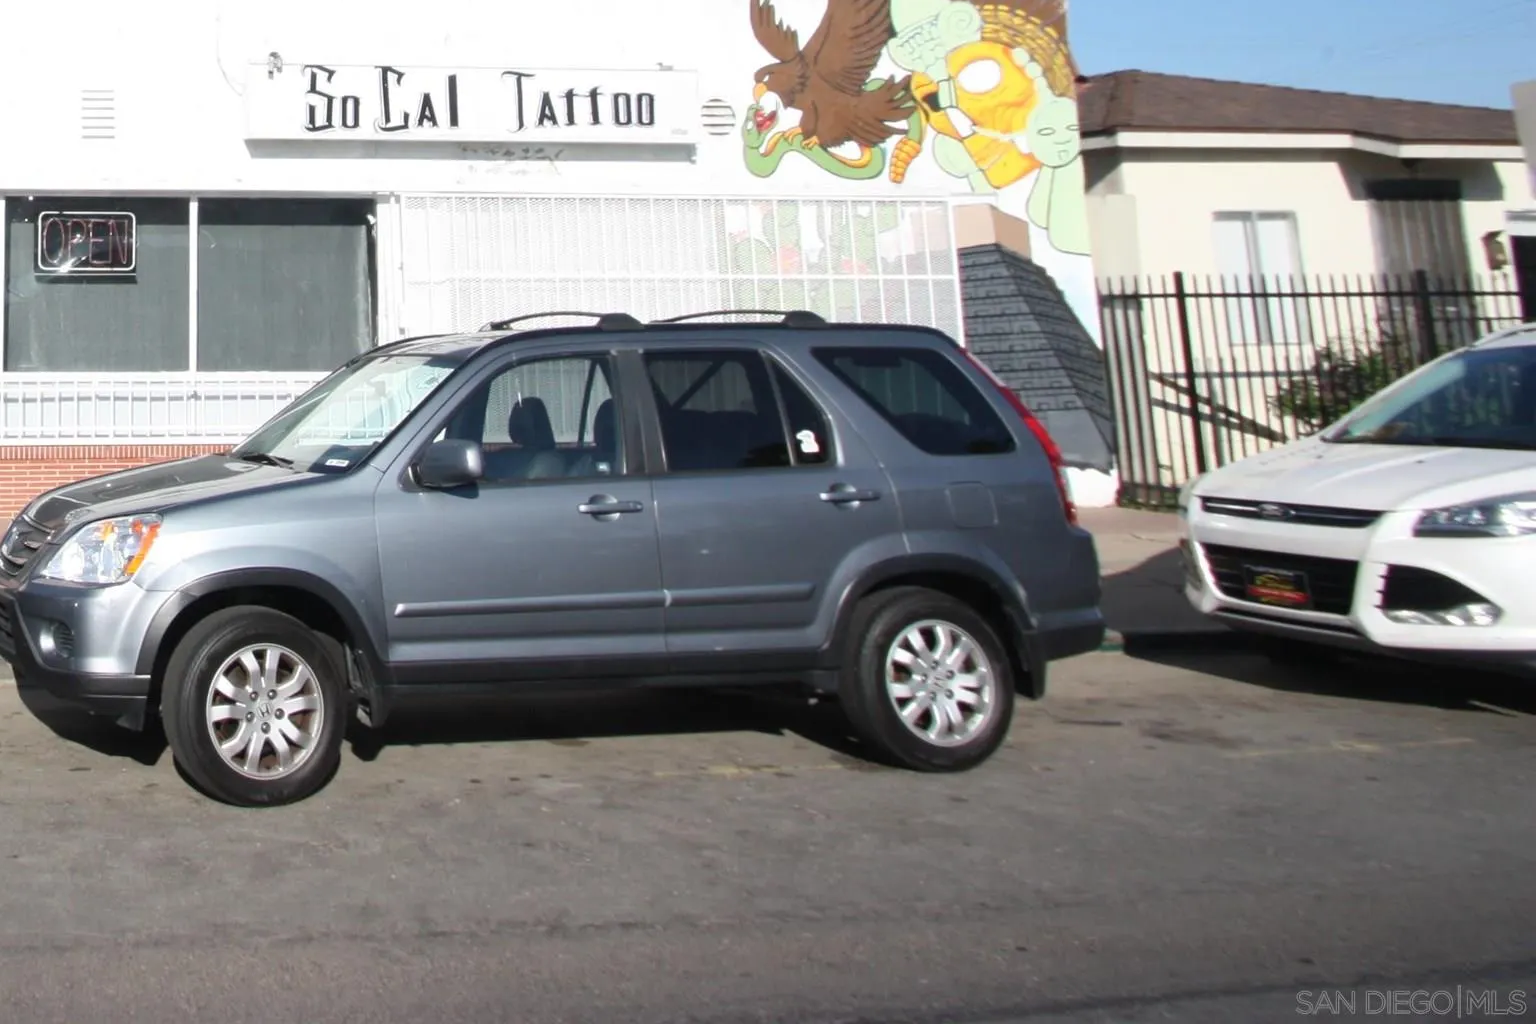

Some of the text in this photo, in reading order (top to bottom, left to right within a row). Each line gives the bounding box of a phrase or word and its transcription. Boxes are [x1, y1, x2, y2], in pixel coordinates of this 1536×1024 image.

[301, 64, 361, 132] So
[500, 70, 655, 133] Tattoo
[43, 216, 129, 265] OPEN
